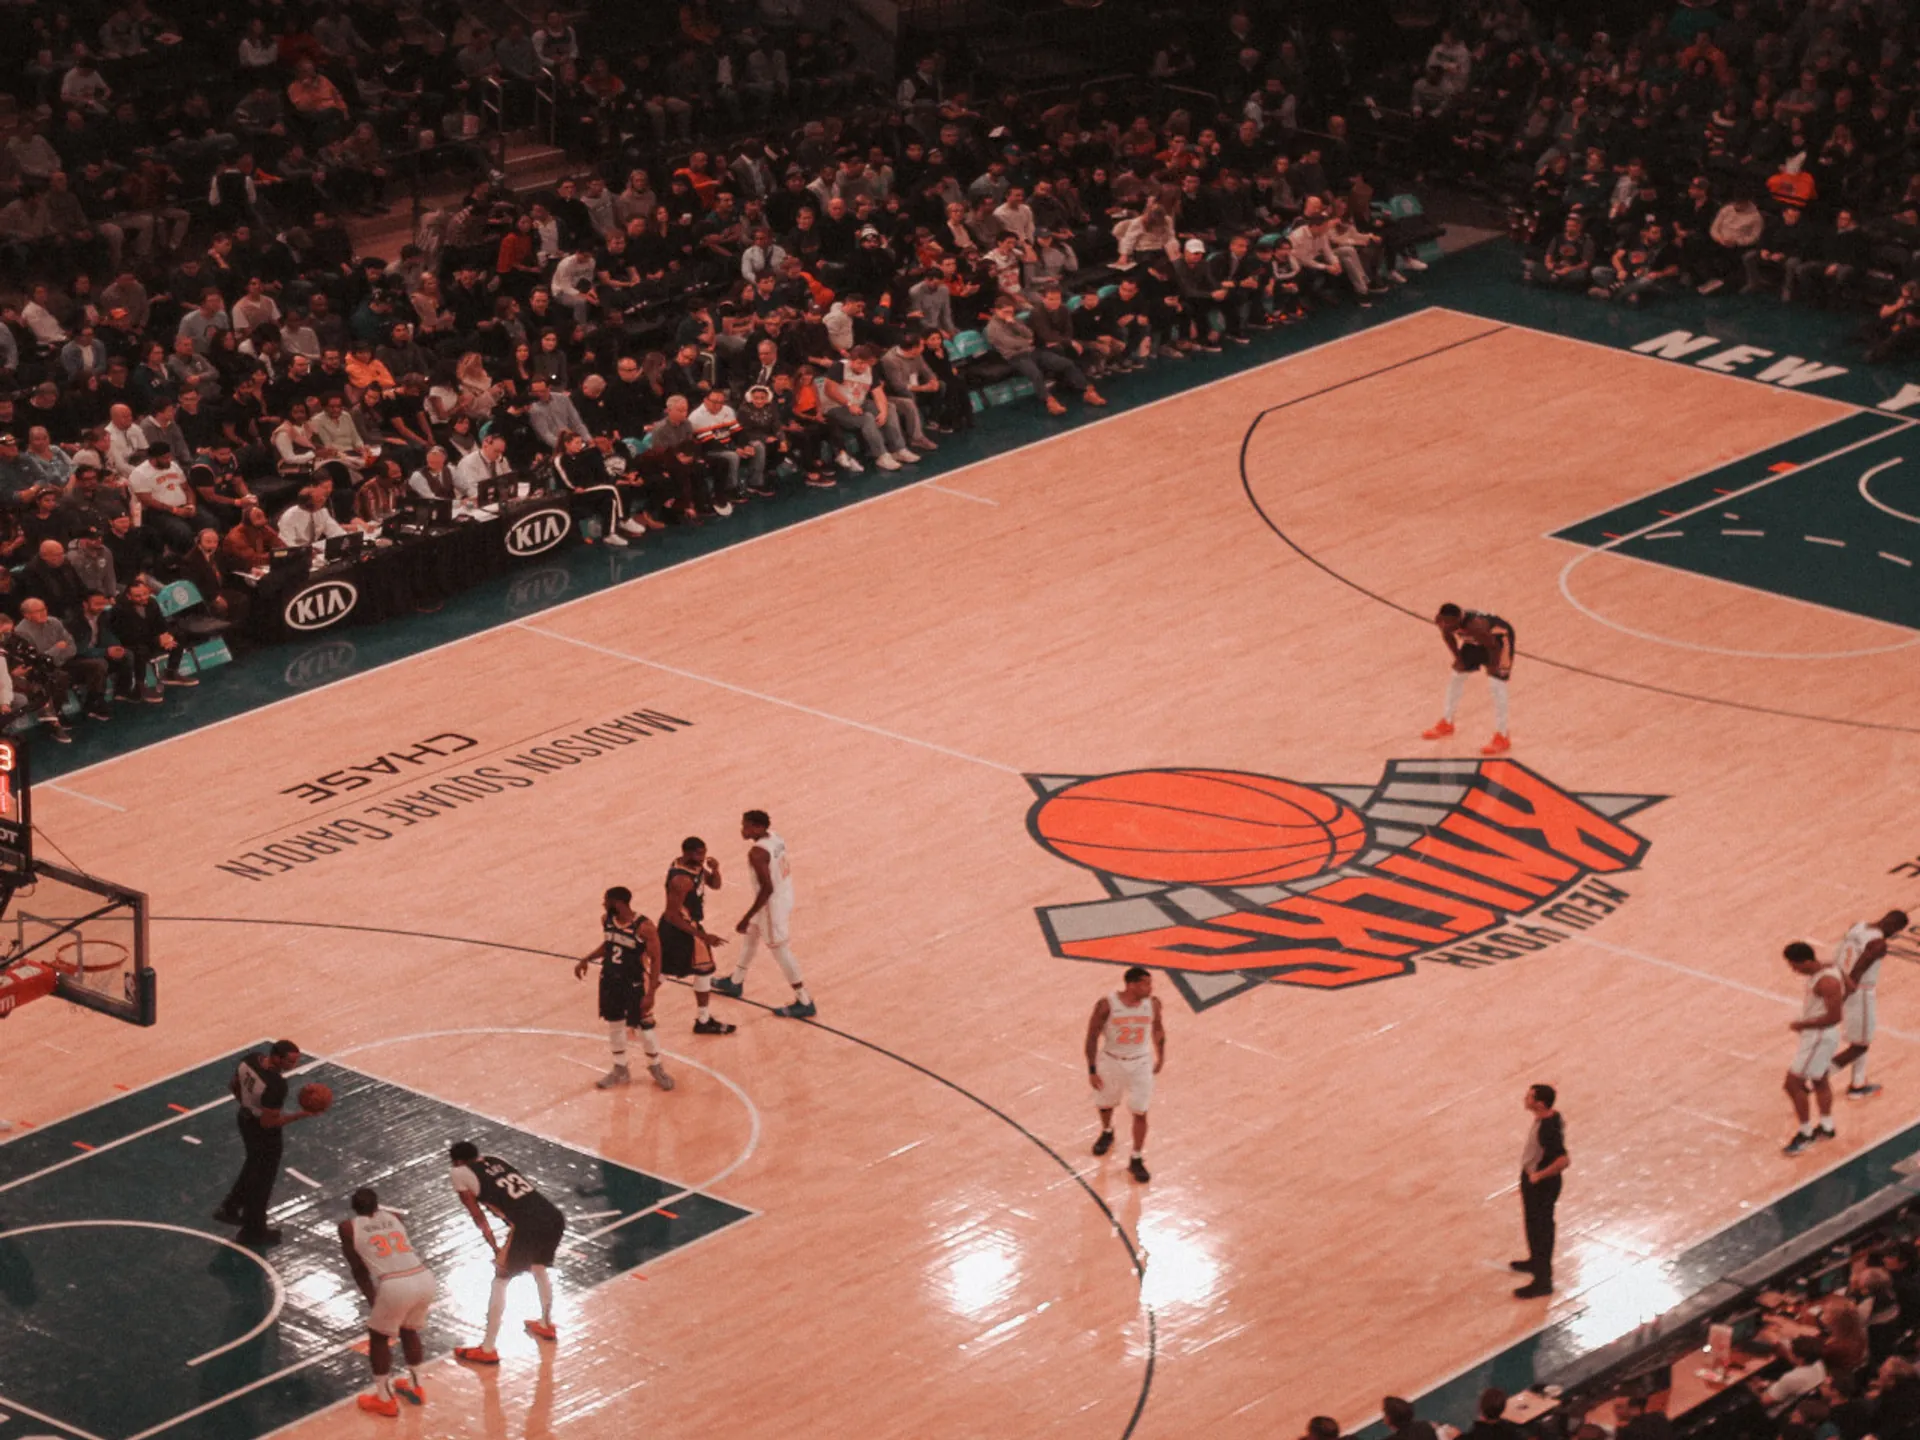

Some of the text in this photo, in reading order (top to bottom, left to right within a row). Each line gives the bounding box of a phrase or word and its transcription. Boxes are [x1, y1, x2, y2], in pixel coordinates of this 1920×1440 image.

[1631, 329, 1849, 387] NEW
[515, 513, 560, 549] KIA
[296, 588, 346, 624] KIA
[279, 733, 478, 804] CHASE
[214, 708, 694, 881] MADISON SQUARE GARDEN
[1057, 758, 1652, 990] KNICKS
[1420, 877, 1631, 969] NEW YORK
[611, 945, 623, 965] 2
[1115, 1026, 1146, 1045] 23
[495, 1172, 534, 1200] 23
[368, 1230, 413, 1258] 32
